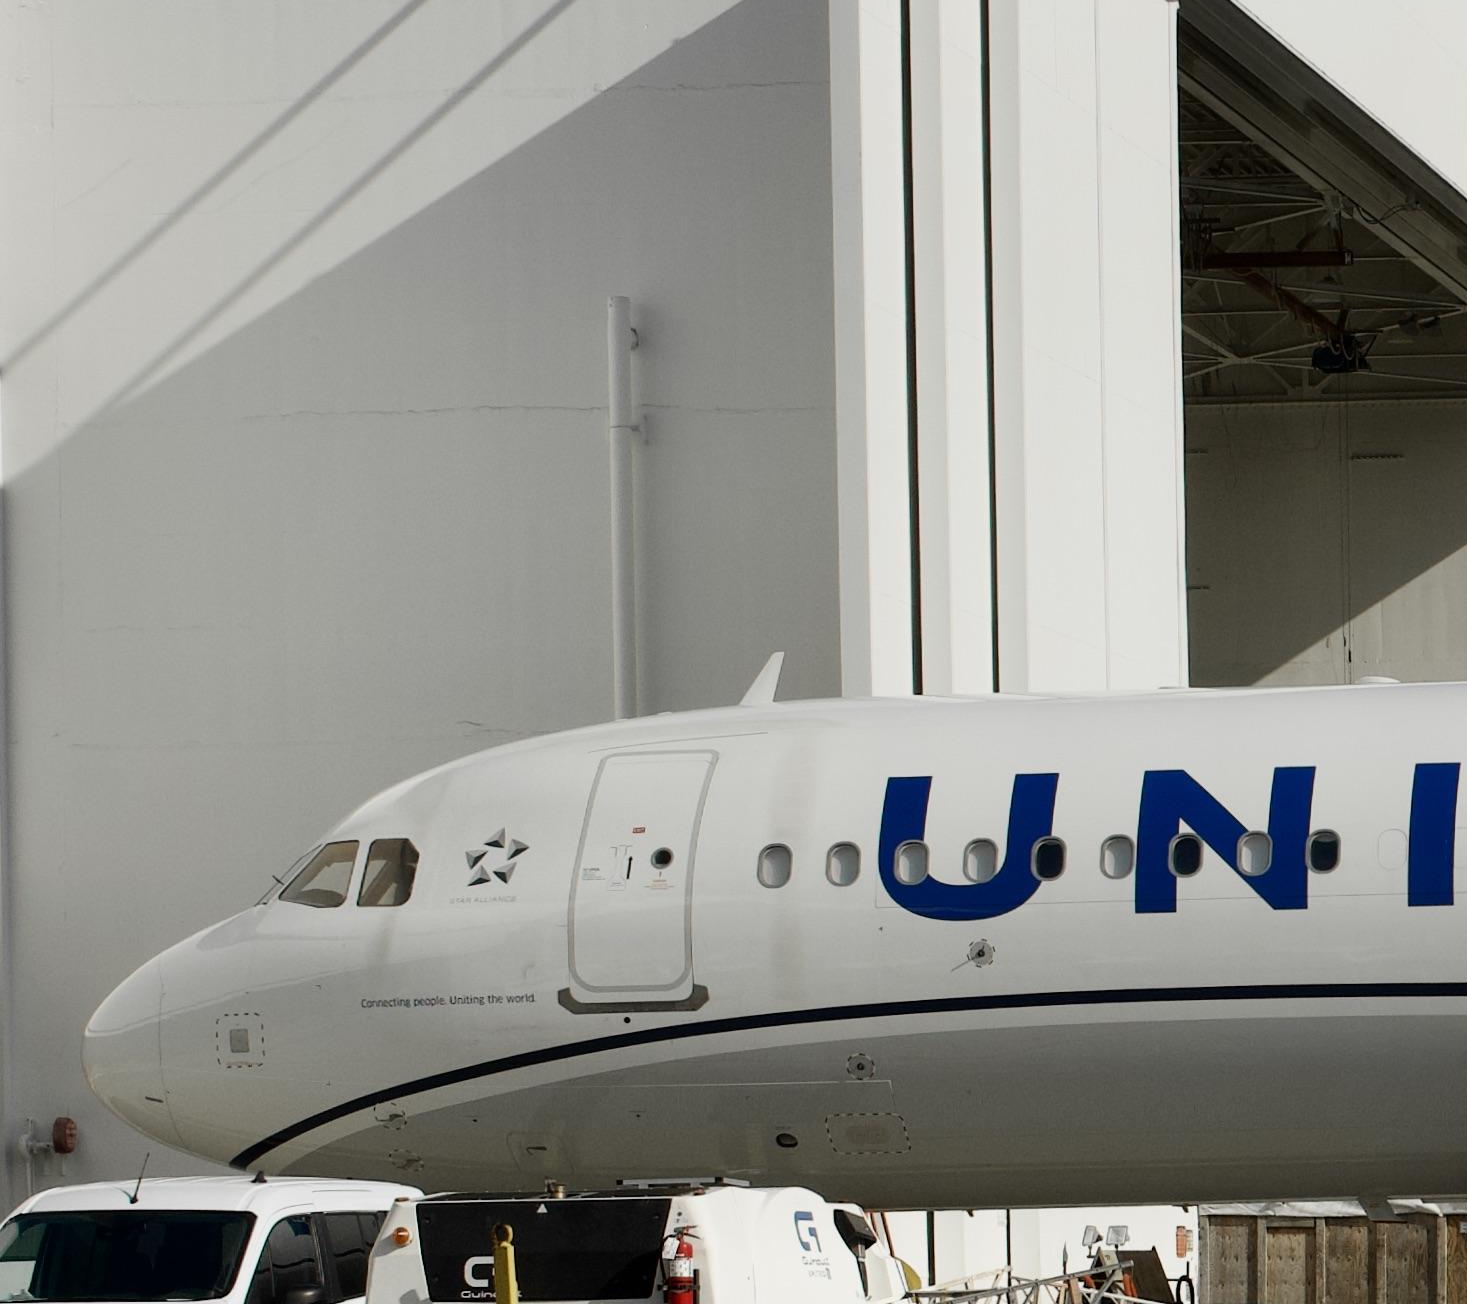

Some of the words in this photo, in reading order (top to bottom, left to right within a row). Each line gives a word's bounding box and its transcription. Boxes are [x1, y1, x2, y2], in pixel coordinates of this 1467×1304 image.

[361, 997, 411, 1008] Connecting
[414, 995, 446, 1007] people.
[450, 995, 485, 1006] Uniting
[488, 994, 503, 1003] the
[506, 993, 536, 1003] world.
